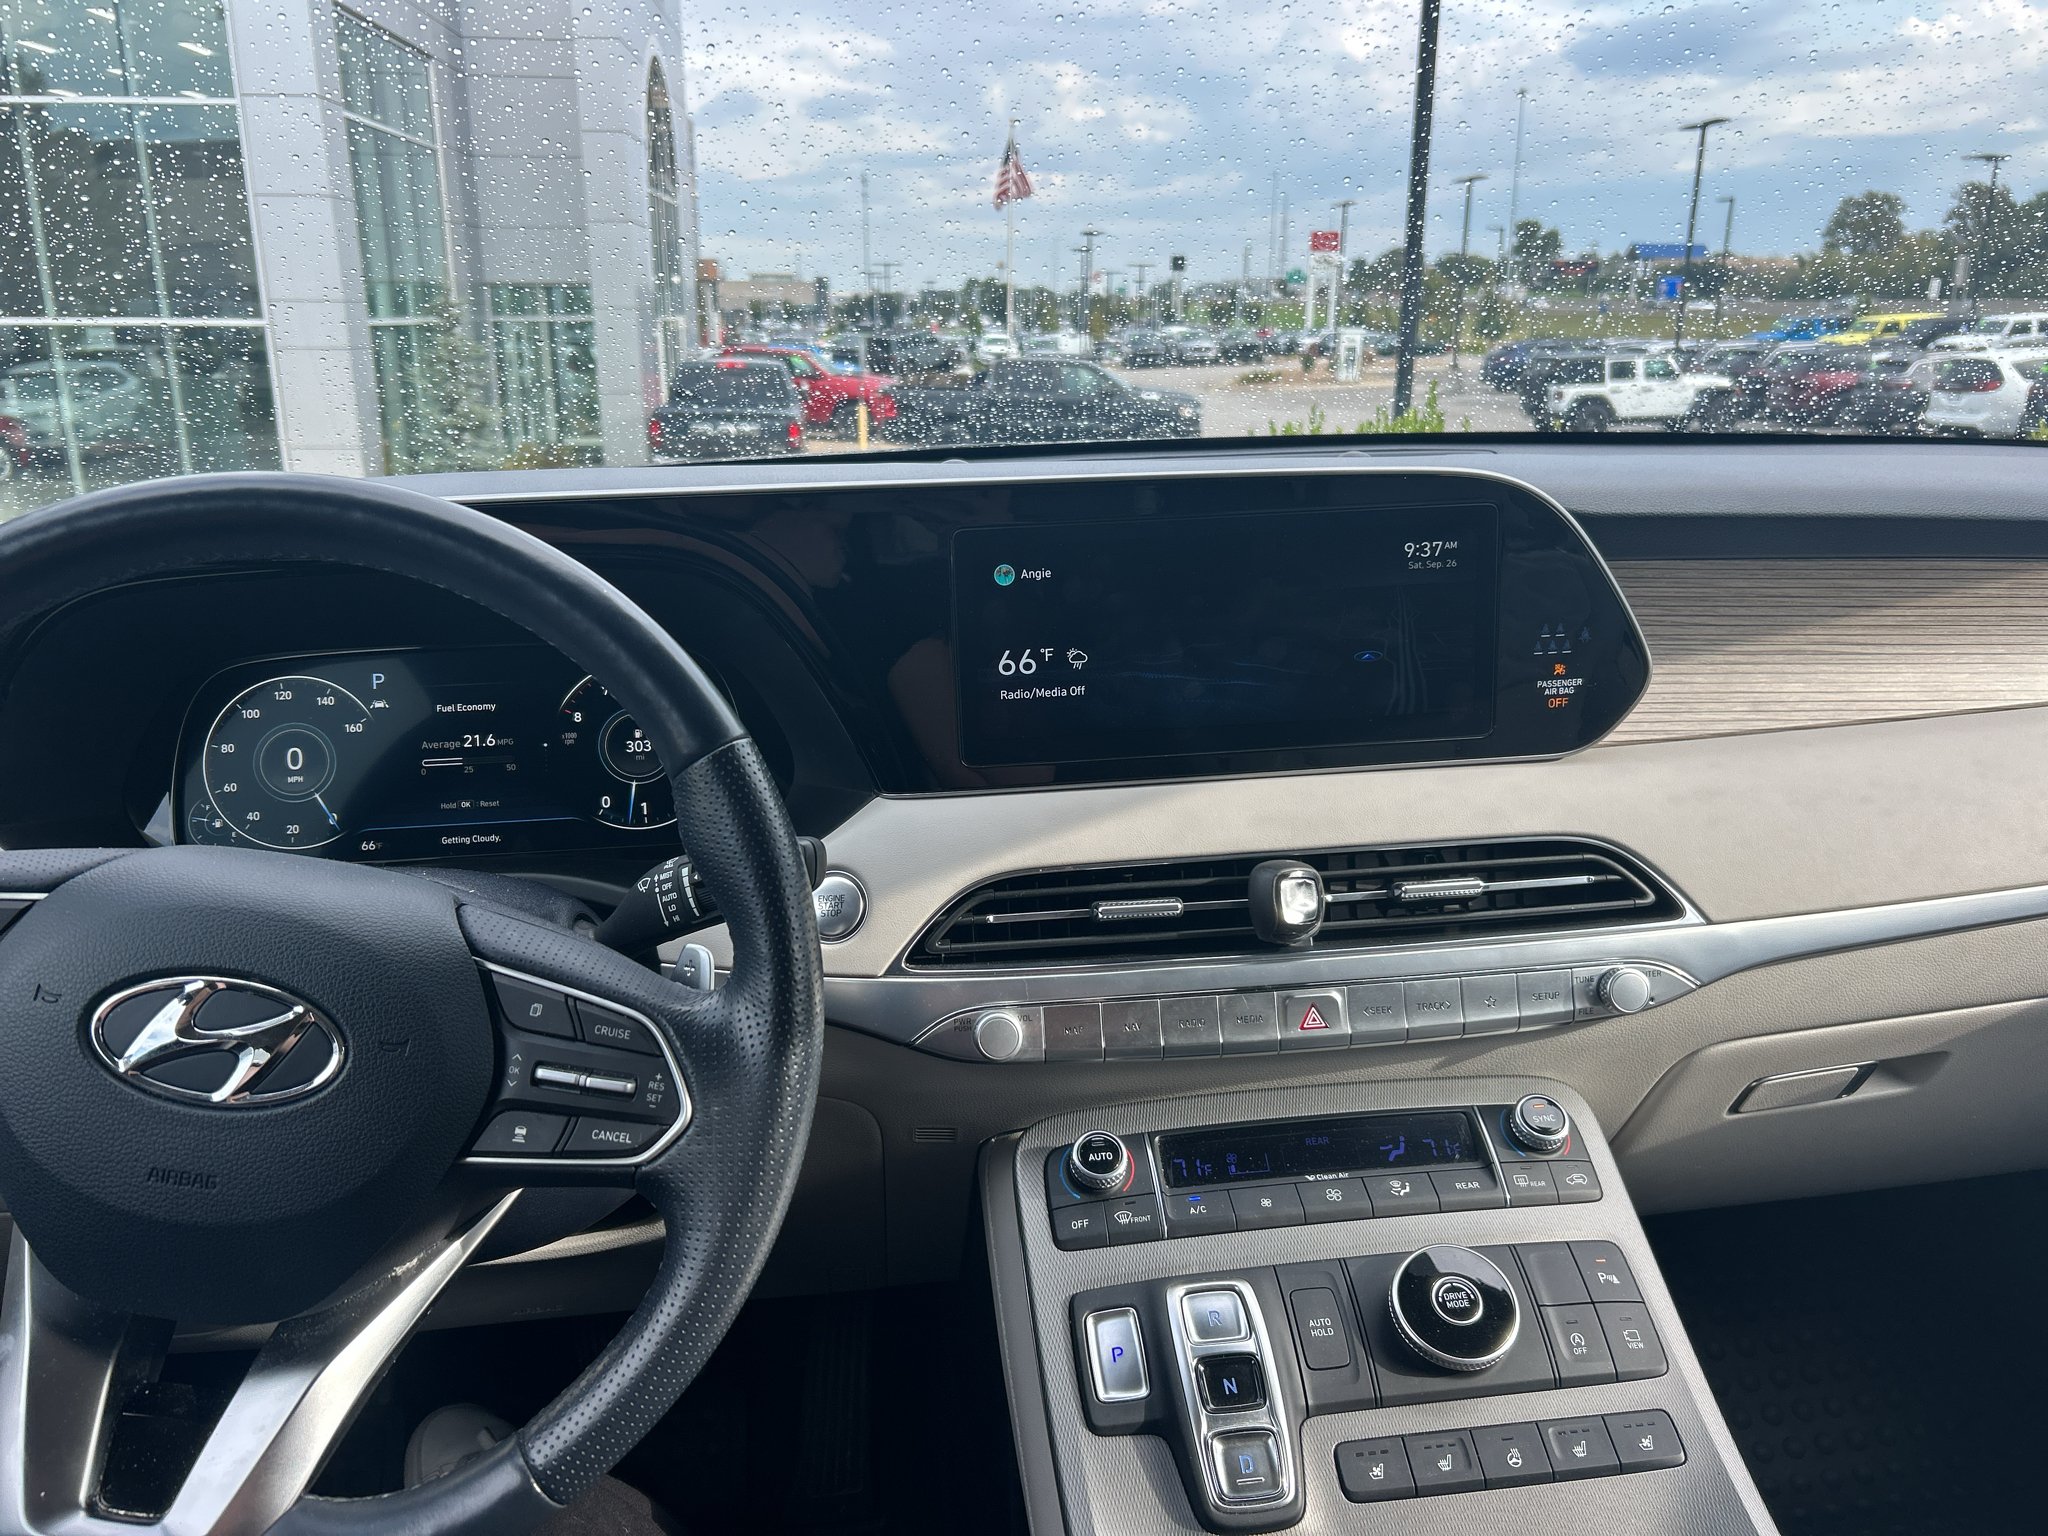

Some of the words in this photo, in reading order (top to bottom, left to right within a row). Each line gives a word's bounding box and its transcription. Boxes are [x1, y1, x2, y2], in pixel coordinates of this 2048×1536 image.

[1404, 541, 1443, 558] 9:37
[1408, 561, 1424, 570] Sat.
[1426, 560, 1444, 570] Sep.
[1445, 559, 1457, 568] 26
[1020, 567, 1052, 581] Angie
[371, 673, 385, 690] P
[1536, 678, 1583, 688] PASSENGER
[274, 690, 292, 700] 120
[1000, 686, 1067, 700] Radio/Media
[1069, 685, 1086, 697] Off
[1558, 686, 1575, 695] BAG
[316, 696, 335, 706] 140
[1547, 697, 1569, 708] OFF
[436, 703, 455, 713] Fuel
[457, 703, 496, 713] Economy
[241, 709, 260, 719] 100
[573, 711, 582, 722] 8
[345, 723, 363, 733] 160
[421, 741, 461, 750] Average
[463, 733, 496, 748] 21.6
[497, 738, 514, 746] MPG
[564, 738, 575, 746] rpm
[625, 740, 652, 753] 303
[220, 743, 235, 753] 80
[286, 747, 303, 770] 0
[420, 768, 427, 776] 0
[463, 766, 474, 774] 25
[506, 763, 517, 771] 50
[287, 775, 304, 783] MPH
[223, 782, 238, 792] 60
[440, 802, 457, 810] Hold
[601, 796, 611, 808] 0
[640, 802, 648, 815] 1
[246, 811, 260, 821] 40
[286, 825, 300, 834] 20
[441, 835, 471, 845] Getting
[472, 833, 502, 844] Cloudy.
[660, 870, 674, 881] MIST
[661, 881, 673, 891] OFF
[662, 892, 678, 903] AUTO
[817, 894, 845, 903] ENGINE
[668, 904, 677, 912] LO
[817, 901, 845, 910] START
[672, 914, 681, 923] HI
[820, 909, 842, 918] STOP
[1574, 976, 1595, 984] TUNE
[1532, 991, 1561, 1001] SETUP
[1578, 1007, 1595, 1016] FILE
[1178, 1017, 1206, 1029] RADIO
[1236, 1014, 1264, 1025] MEDIA
[594, 1024, 631, 1040] CRUISE
[1122, 1021, 1143, 1033] NAV
[508, 1065, 520, 1075] OK
[647, 1080, 665, 1091] RES
[646, 1093, 663, 1103] SET
[1532, 1114, 1556, 1123] SYNC
[591, 1129, 632, 1144] CANCEL
[1305, 1136, 1330, 1146] REAR
[1088, 1152, 1113, 1162] AUTO
[146, 1167, 218, 1190] AIRBAG
[1316, 1173, 1338, 1181] Clean
[1455, 1181, 1480, 1190] REAR
[1189, 1205, 1207, 1215] A/C
[1130, 1214, 1151, 1224] FRONT
[1071, 1219, 1089, 1230] OFF
[1443, 1291, 1468, 1301] DRIVE
[1446, 1299, 1470, 1309] MODE
[1207, 1310, 1222, 1326] R
[1309, 1318, 1332, 1328] AUTO
[1310, 1327, 1334, 1337] HOLD
[1626, 1341, 1644, 1349] VIEW
[1111, 1346, 1124, 1363] P
[1573, 1346, 1589, 1355] OFF
[1222, 1377, 1238, 1395] N
[1238, 1455, 1254, 1474] D
